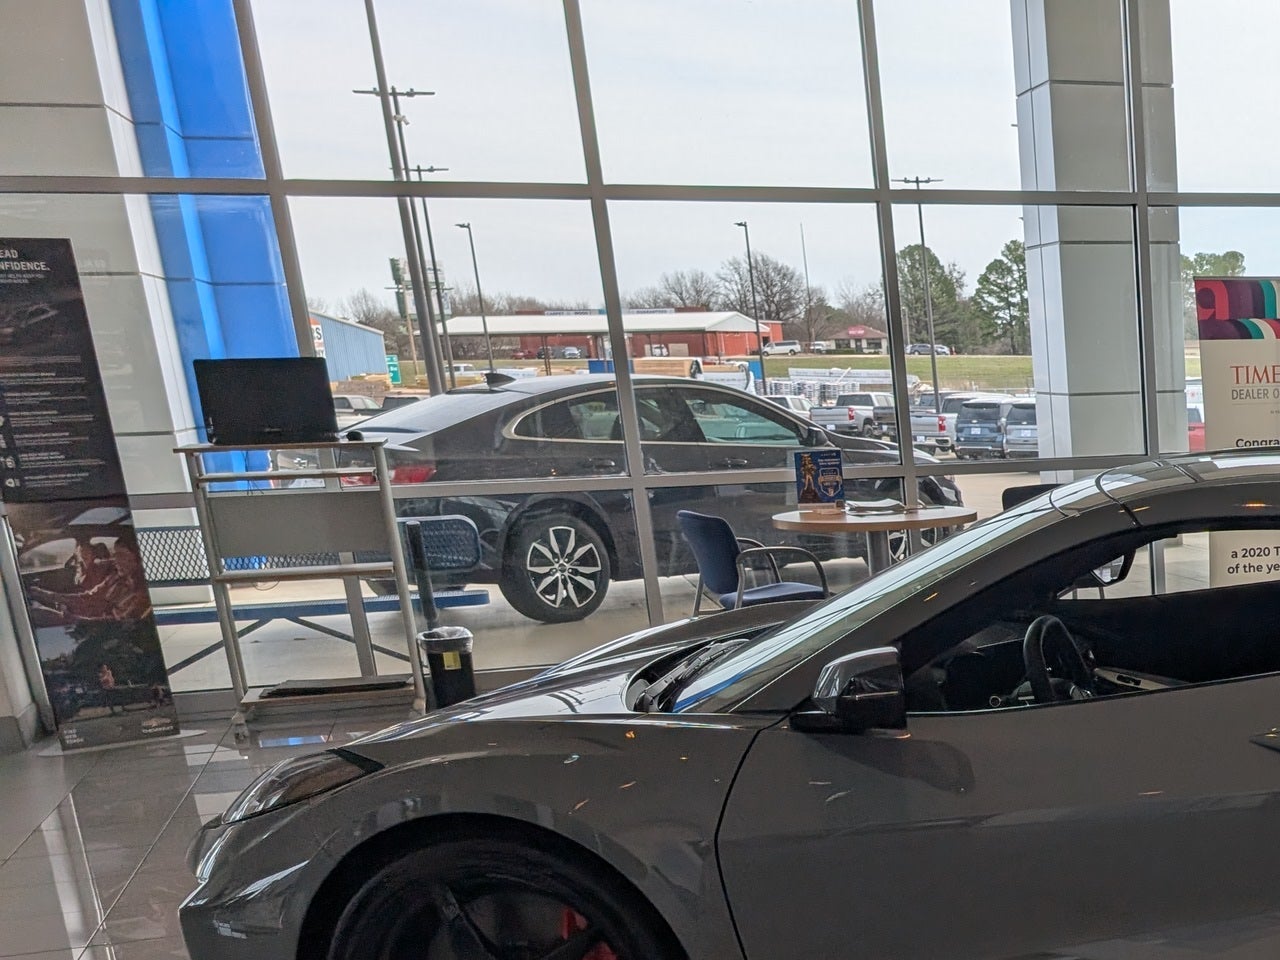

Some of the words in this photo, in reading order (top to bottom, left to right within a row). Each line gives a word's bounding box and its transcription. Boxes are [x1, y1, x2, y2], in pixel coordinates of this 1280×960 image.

[1231, 388, 1269, 400] DEALER
[1231, 550, 1238, 559] a
[1241, 547, 1271, 558] 2020
[1227, 563, 1240, 575] of
[1243, 562, 1263, 574] the
